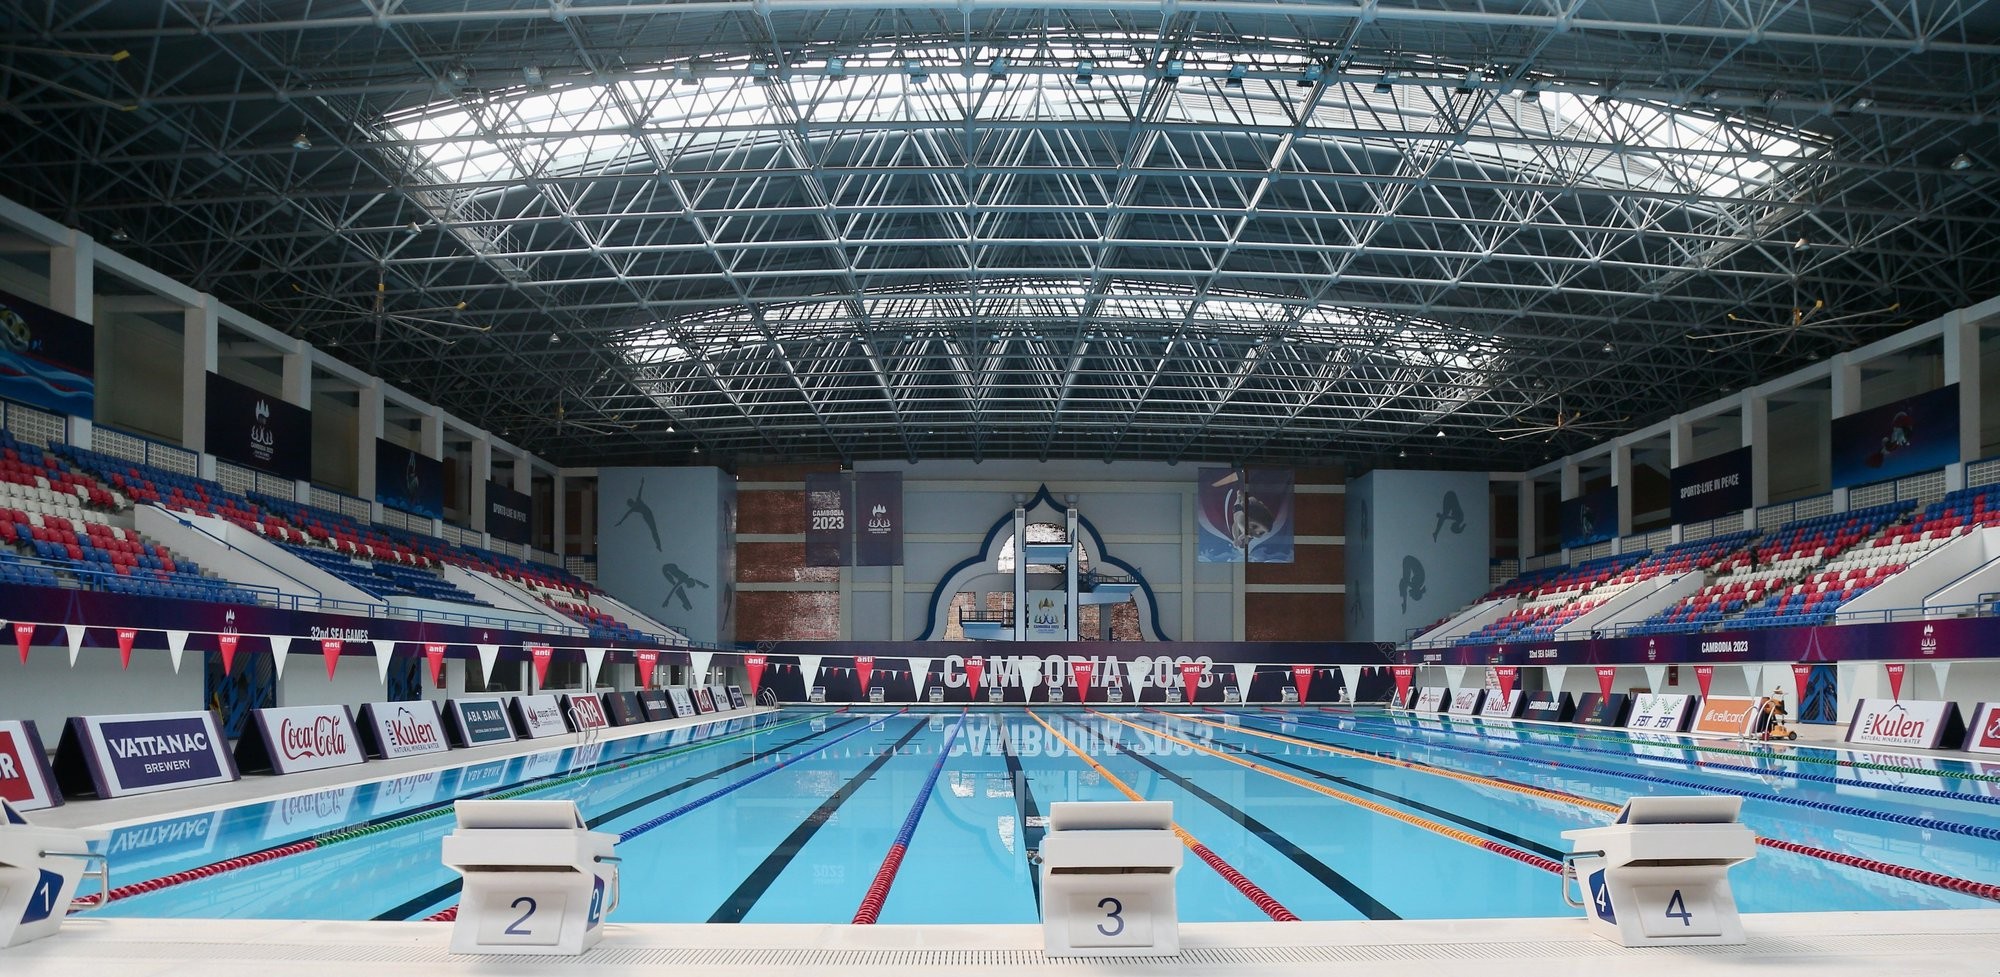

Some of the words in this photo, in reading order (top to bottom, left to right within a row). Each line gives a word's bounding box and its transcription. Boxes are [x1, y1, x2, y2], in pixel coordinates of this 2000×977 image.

[1721, 473, 1739, 488] PEACE
[812, 517, 845, 530] 2023
[311, 626, 329, 641] 32nd
[345, 629, 368, 643] GAMES
[1545, 649, 1557, 658] GAMES
[1701, 641, 1732, 653] CAMBODIA
[1733, 641, 1748, 652] 2023
[747, 657, 764, 665] anti
[966, 659, 983, 667] anti
[1075, 664, 1091, 672] anti
[1184, 665, 1200, 673] anti
[1395, 668, 1411, 676] anti
[1498, 668, 1513, 676] anti
[1794, 666, 1809, 674] anti
[467, 711, 481, 722] ABA
[483, 709, 501, 720] BANK
[1632, 715, 1652, 727] FBT
[1653, 716, 1675, 728] FBT
[392, 717, 437, 746] Kulen
[1870, 713, 1924, 738] Kulen
[108, 732, 208, 759] VATTANAC
[144, 759, 191, 774] BREWERY
[40, 881, 49, 912] 1
[1596, 883, 1607, 912] 4
[592, 888, 600, 920] 2
[1665, 889, 1693, 926] 4
[504, 896, 537, 935] 2
[1096, 897, 1125, 937] 3
